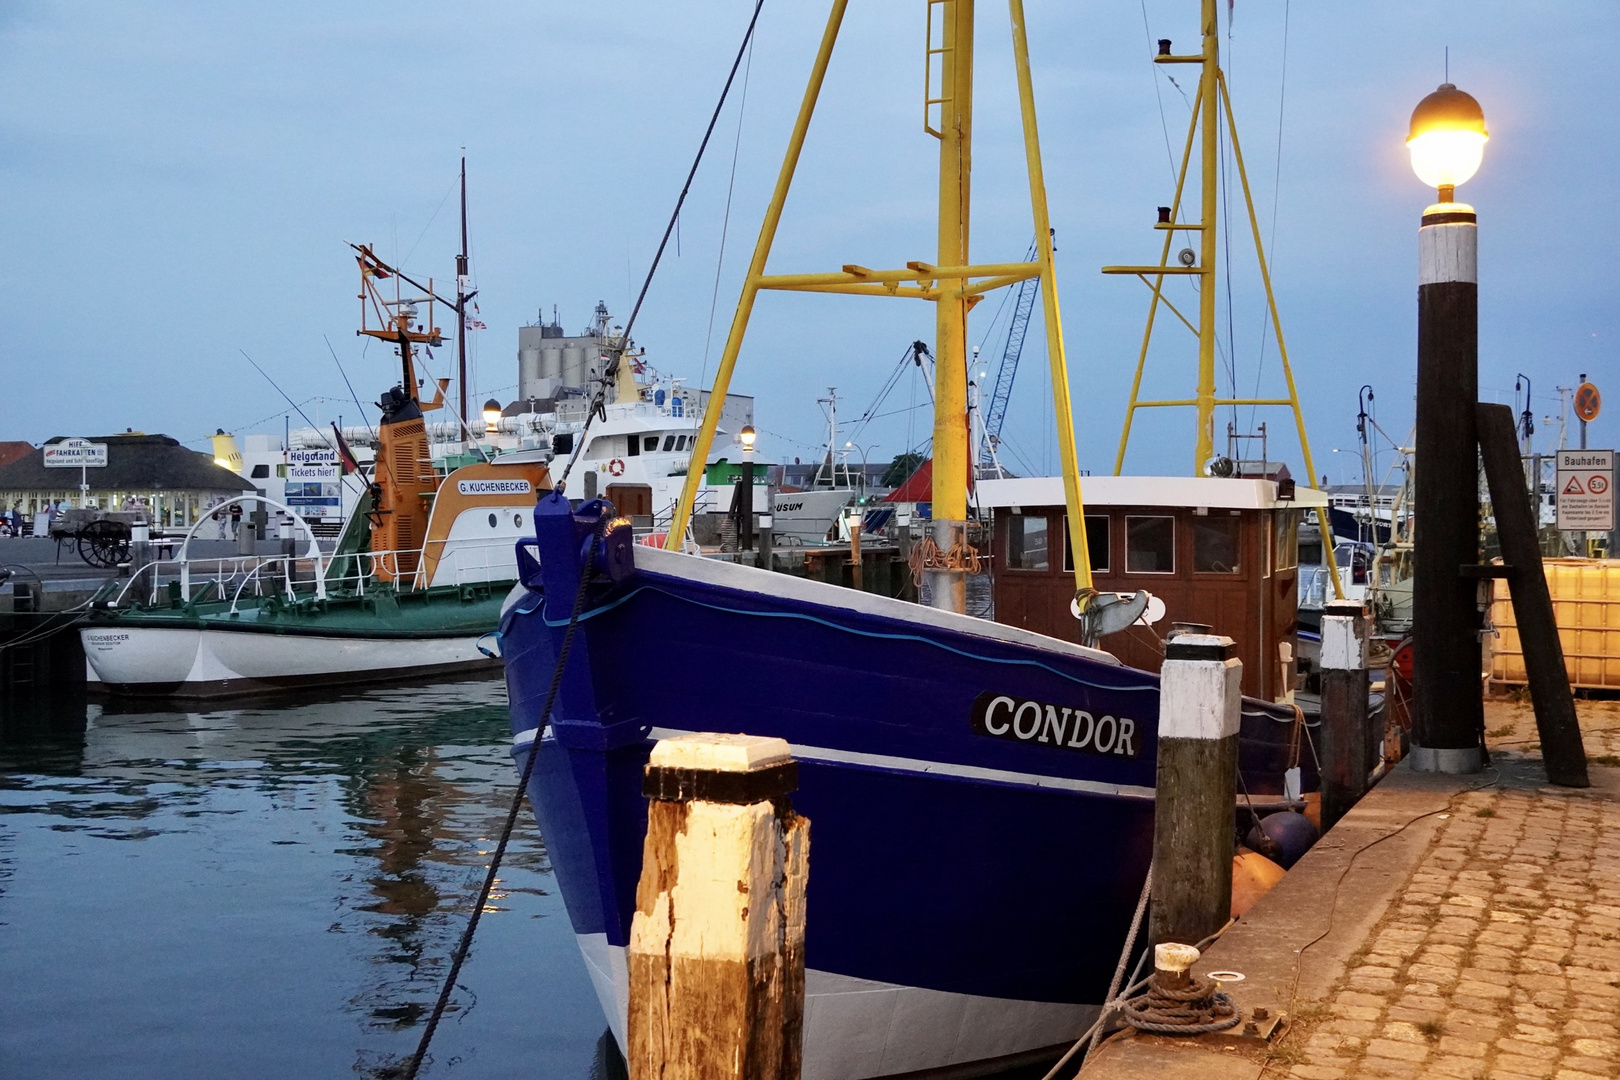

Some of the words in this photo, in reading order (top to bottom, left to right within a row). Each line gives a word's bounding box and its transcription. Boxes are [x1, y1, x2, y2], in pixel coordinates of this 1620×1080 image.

[290, 451, 335, 462] Helgoland
[1564, 456, 1606, 466] Bauhafen
[290, 468, 316, 477] Tickets
[318, 468, 335, 477] hier!
[460, 483, 468, 492] G.
[470, 482, 530, 492] KUCHENBECKER
[774, 503, 803, 512] ÜSUM
[984, 696, 1135, 756] CONDOR
